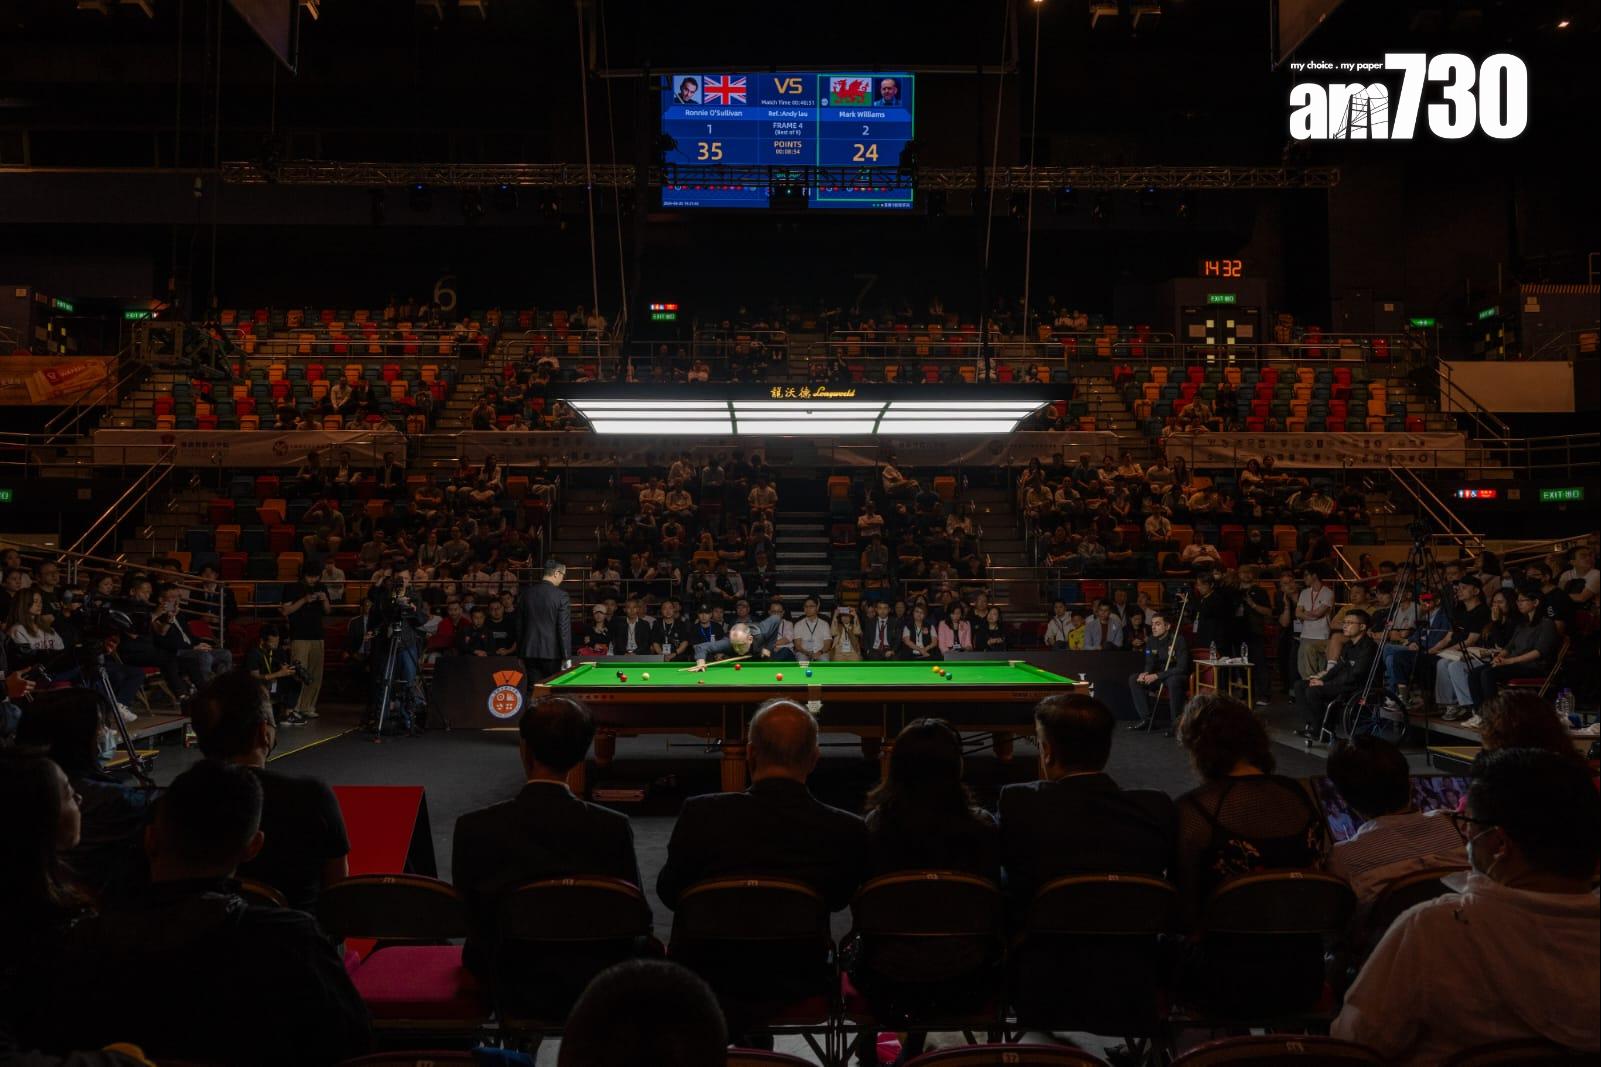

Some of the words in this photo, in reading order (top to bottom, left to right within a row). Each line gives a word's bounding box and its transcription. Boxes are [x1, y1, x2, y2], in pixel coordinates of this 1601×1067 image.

[774, 77, 803, 94] VS
[709, 109, 743, 117] O'Sullivan
[839, 110, 856, 118] Mark
[857, 110, 886, 118] Williams
[706, 124, 712, 135] 1
[772, 121, 798, 129] FRAME
[861, 125, 870, 136] 2
[774, 140, 802, 148] POINTS
[697, 142, 723, 160] 35
[852, 143, 879, 162] 24
[433, 274, 457, 313] 6
[770, 385, 811, 398] 龍沃德
[1543, 490, 1563, 500] EXIT
